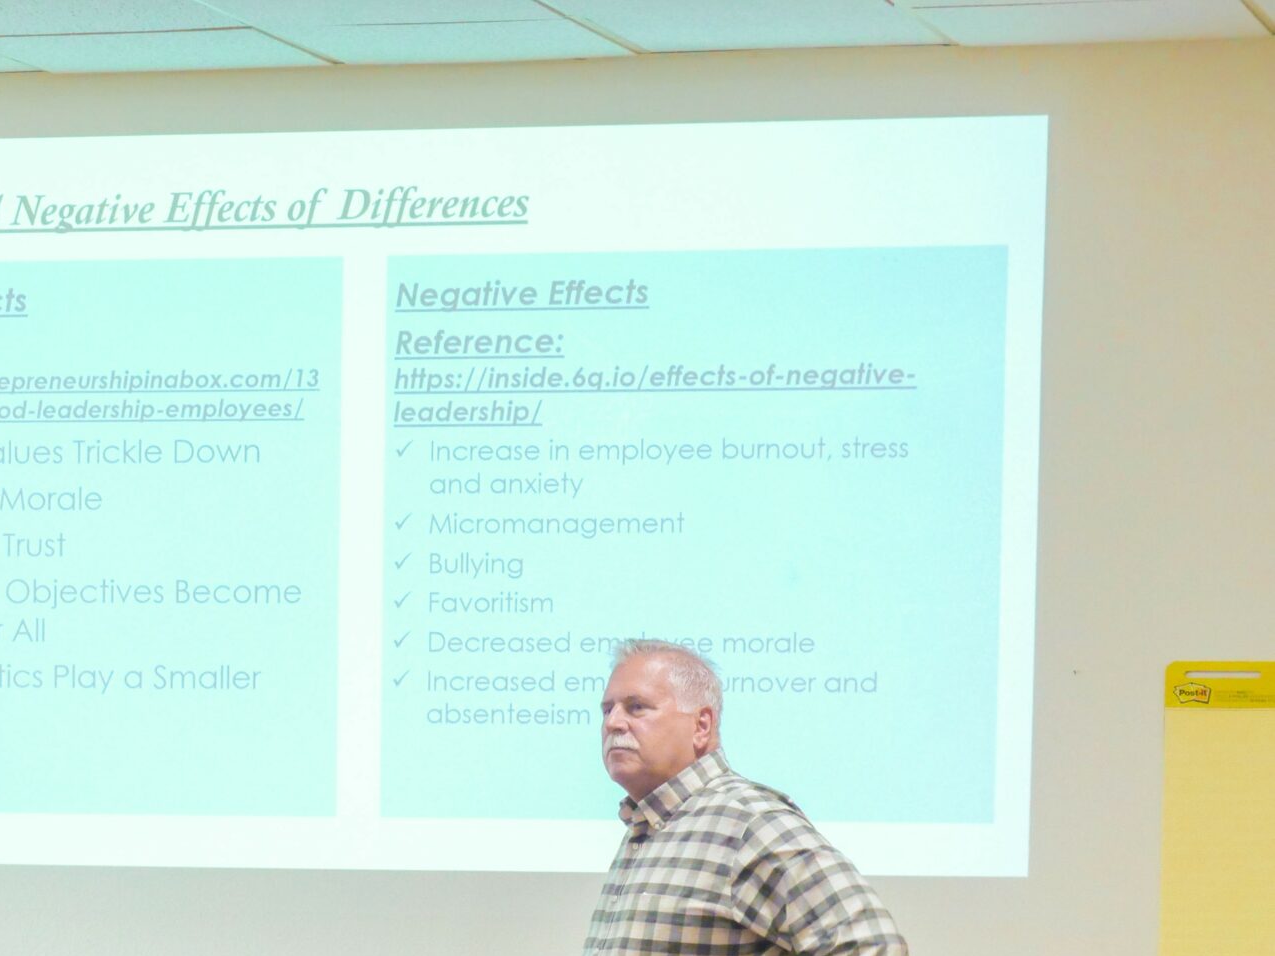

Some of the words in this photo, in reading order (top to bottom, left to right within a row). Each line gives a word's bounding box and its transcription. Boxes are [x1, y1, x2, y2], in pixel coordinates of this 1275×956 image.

[11, 193, 155, 233] Negative
[163, 191, 277, 231] Effects
[287, 188, 328, 229] of
[337, 187, 529, 228] Differences
[396, 281, 537, 312] Negative
[548, 279, 649, 305] Effects
[396, 328, 564, 355] Reference:
[394, 400, 542, 427] leadership/
[74, 439, 162, 465] Trickle
[174, 439, 261, 464] Down
[431, 440, 541, 462] Increase
[549, 439, 570, 462] in
[579, 438, 713, 465] employee
[722, 438, 833, 461] burnout,
[841, 436, 909, 459] stress
[430, 474, 481, 496] and
[489, 472, 583, 498] anxiety
[0, 487, 102, 511] Morale
[429, 512, 684, 538] Micromanagement
[2, 533, 66, 558] Trust
[429, 552, 524, 578] Bullying
[6, 579, 164, 608] Objectives
[175, 579, 302, 605] Become
[429, 592, 553, 614] Favoritism
[13, 618, 46, 643] All
[429, 632, 571, 654] Decreased
[580, 631, 713, 653] emee
[723, 632, 815, 654] morale
[54, 664, 114, 694] Play
[124, 669, 143, 689] a
[153, 665, 261, 690] Smaller
[427, 670, 555, 694] Increased
[722, 676, 816, 693] urnover
[824, 671, 878, 694] and
[427, 703, 591, 725] absenteeism
